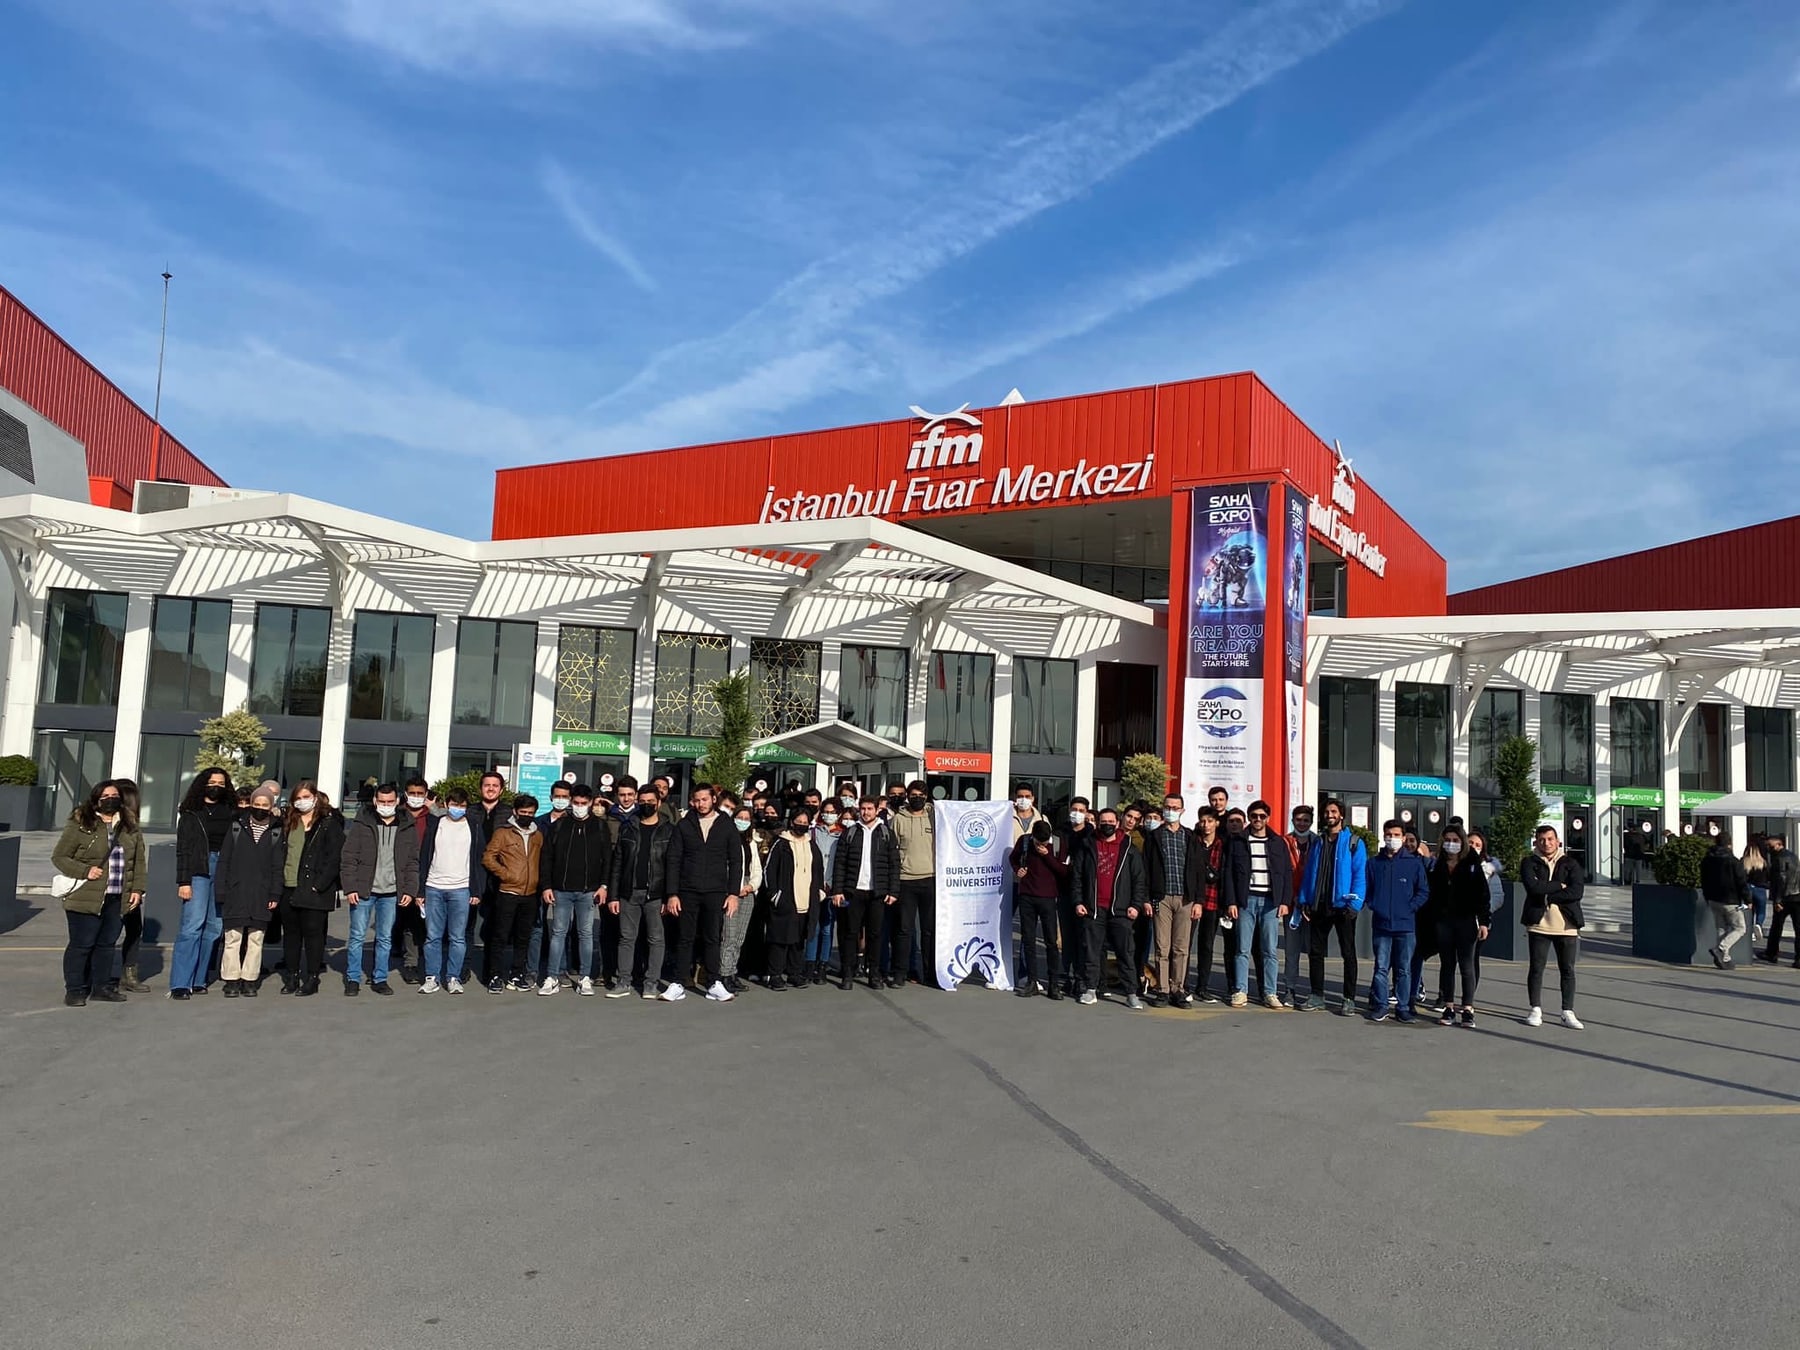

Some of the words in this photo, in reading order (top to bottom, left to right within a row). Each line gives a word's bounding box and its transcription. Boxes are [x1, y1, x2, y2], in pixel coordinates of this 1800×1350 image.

[906, 425, 983, 471] ifm
[902, 476, 984, 513] Fuar
[991, 454, 1154, 505] Merkezi
[1209, 493, 1251, 508] SAHA
[1209, 509, 1250, 524] EXPO
[1189, 625, 1224, 639] ARE
[1227, 623, 1264, 639] YOU
[1194, 639, 1259, 653] READY?
[1197, 708, 1243, 720] EXPO
[935, 757, 981, 767] ÇIKIŞ/EXIT
[1401, 781, 1443, 792] PROTOKOL
[946, 866, 975, 875] BURSA
[976, 864, 1004, 874] TEKNİK
[946, 874, 1004, 888] ÜNİVERSİTESİ
